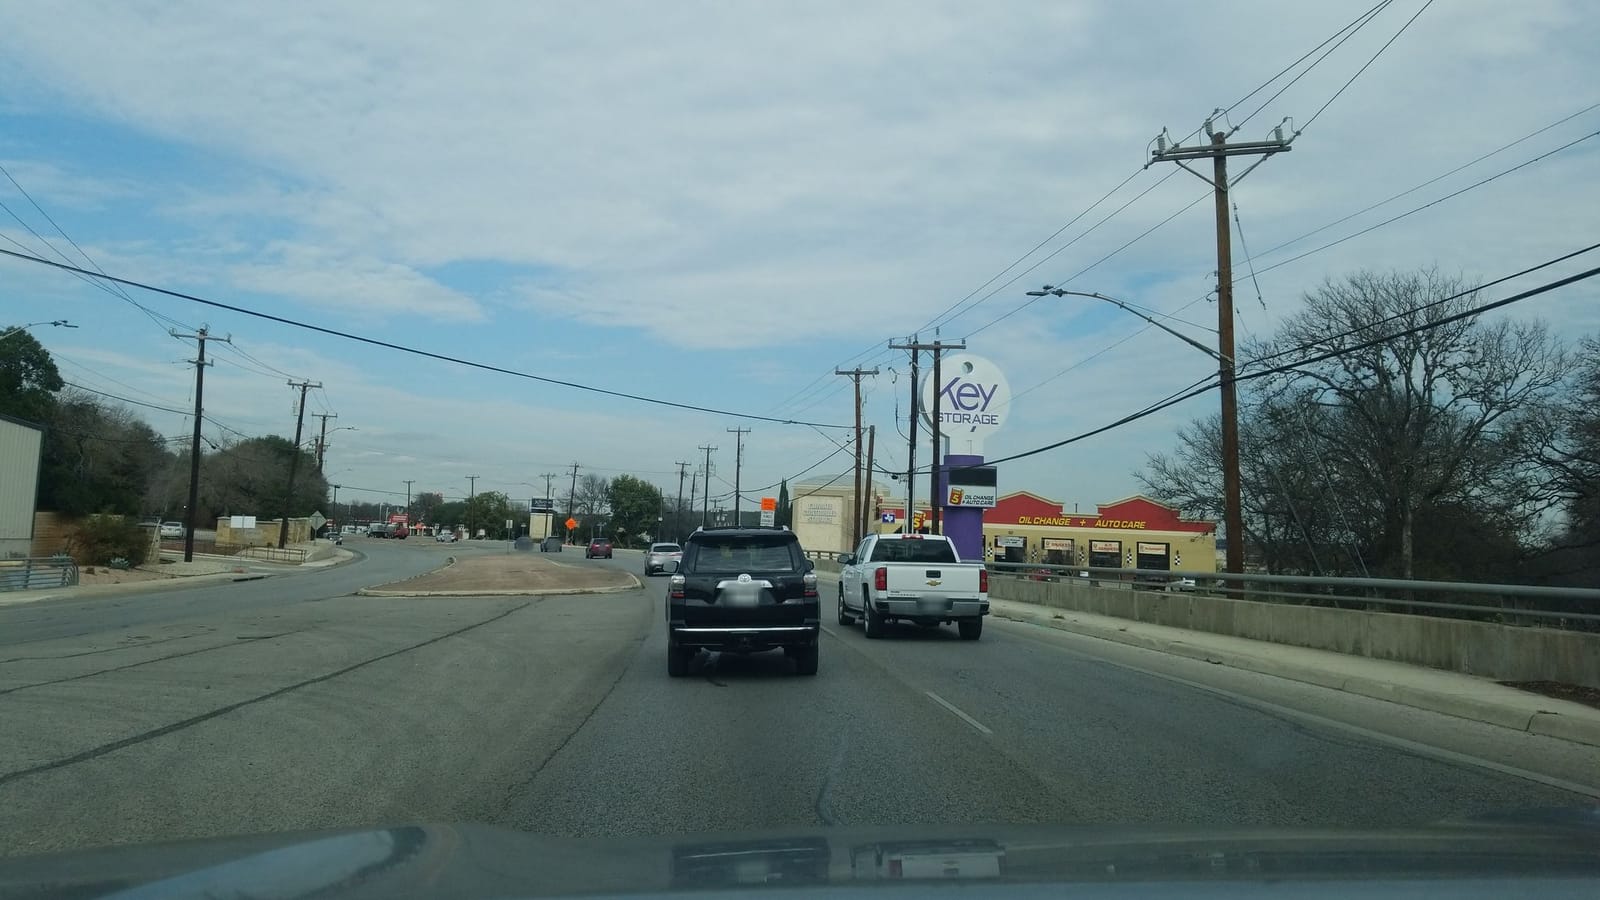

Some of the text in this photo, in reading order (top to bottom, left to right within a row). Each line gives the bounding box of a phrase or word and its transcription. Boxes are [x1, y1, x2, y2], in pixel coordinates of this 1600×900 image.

[940, 376, 998, 412] Key
[939, 412, 999, 425] STORAGE
[1018, 516, 1032, 525] OIL
[1033, 517, 1071, 526] CHANGE
[1095, 519, 1121, 528] AUTO
[1121, 521, 1146, 529] CARE
